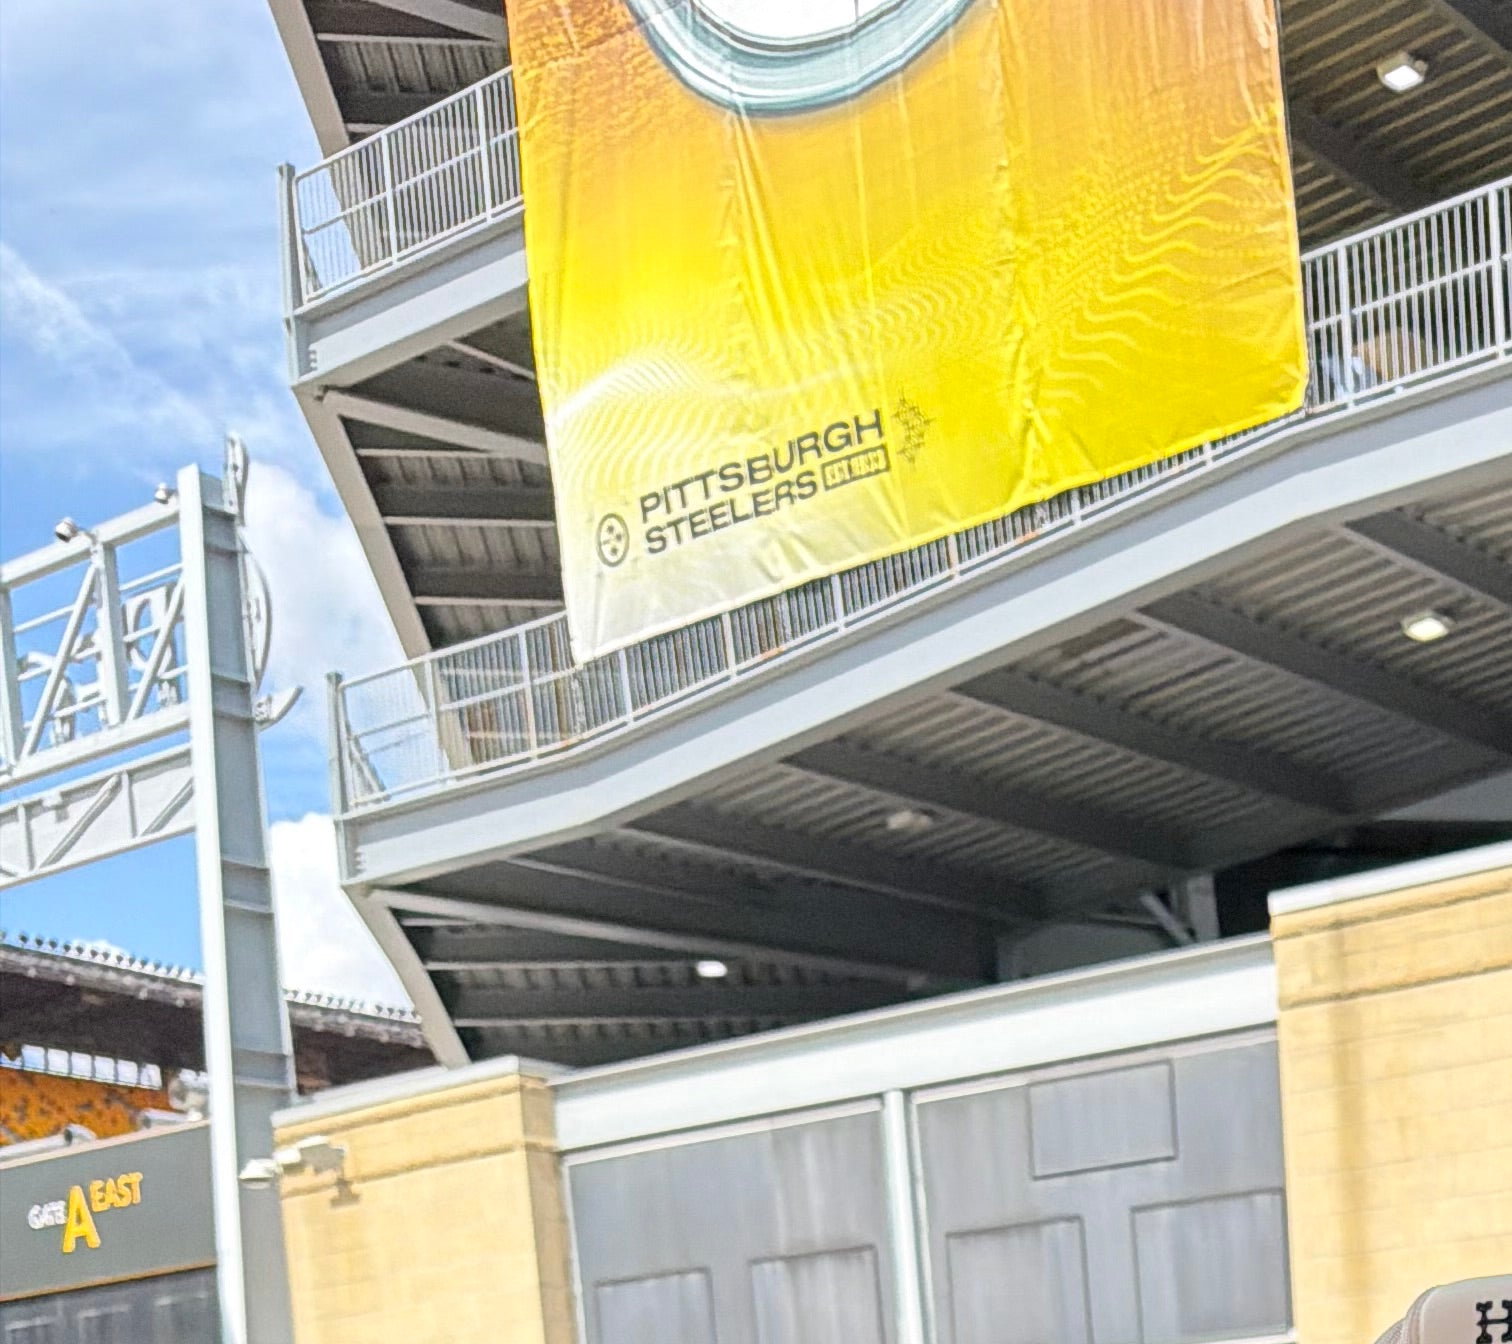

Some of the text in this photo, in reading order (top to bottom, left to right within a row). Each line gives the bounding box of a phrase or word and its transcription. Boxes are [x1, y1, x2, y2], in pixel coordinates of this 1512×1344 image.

[640, 408, 884, 524] PITTSBURGH
[645, 470, 818, 554] STEELERS
[62, 1185, 101, 1253] A
[89, 1171, 143, 1212] EAST
